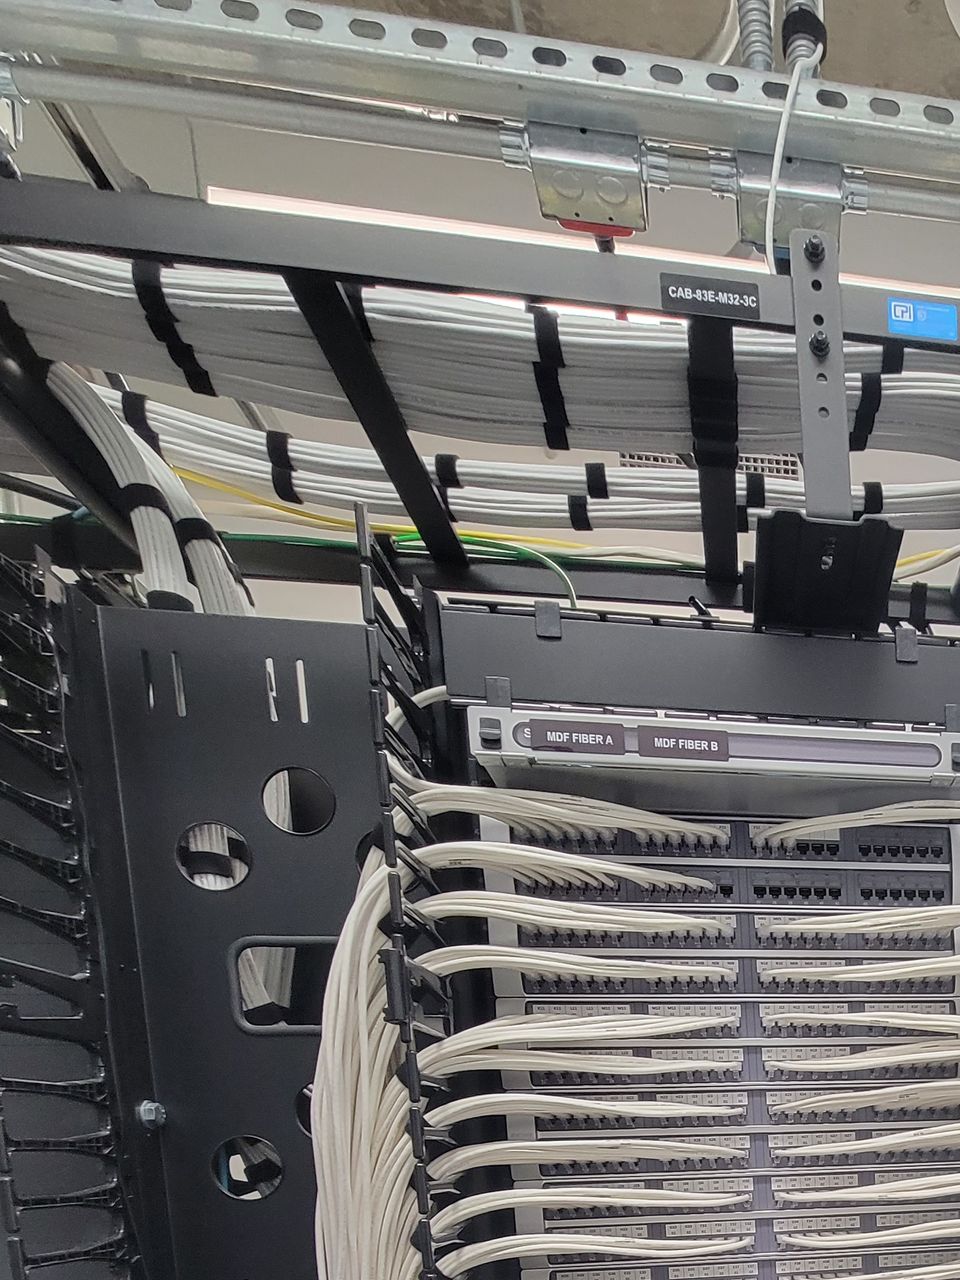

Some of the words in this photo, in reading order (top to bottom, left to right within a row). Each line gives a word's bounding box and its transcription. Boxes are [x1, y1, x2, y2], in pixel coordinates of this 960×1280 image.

[668, 286, 757, 308] CAB-83E-M32-3C
[546, 731, 570, 743] MDF
[572, 734, 603, 744] FIBER
[605, 735, 614, 745] A
[654, 737, 676, 748] MDF
[678, 739, 709, 750] FIBER
[711, 741, 719, 751] B
